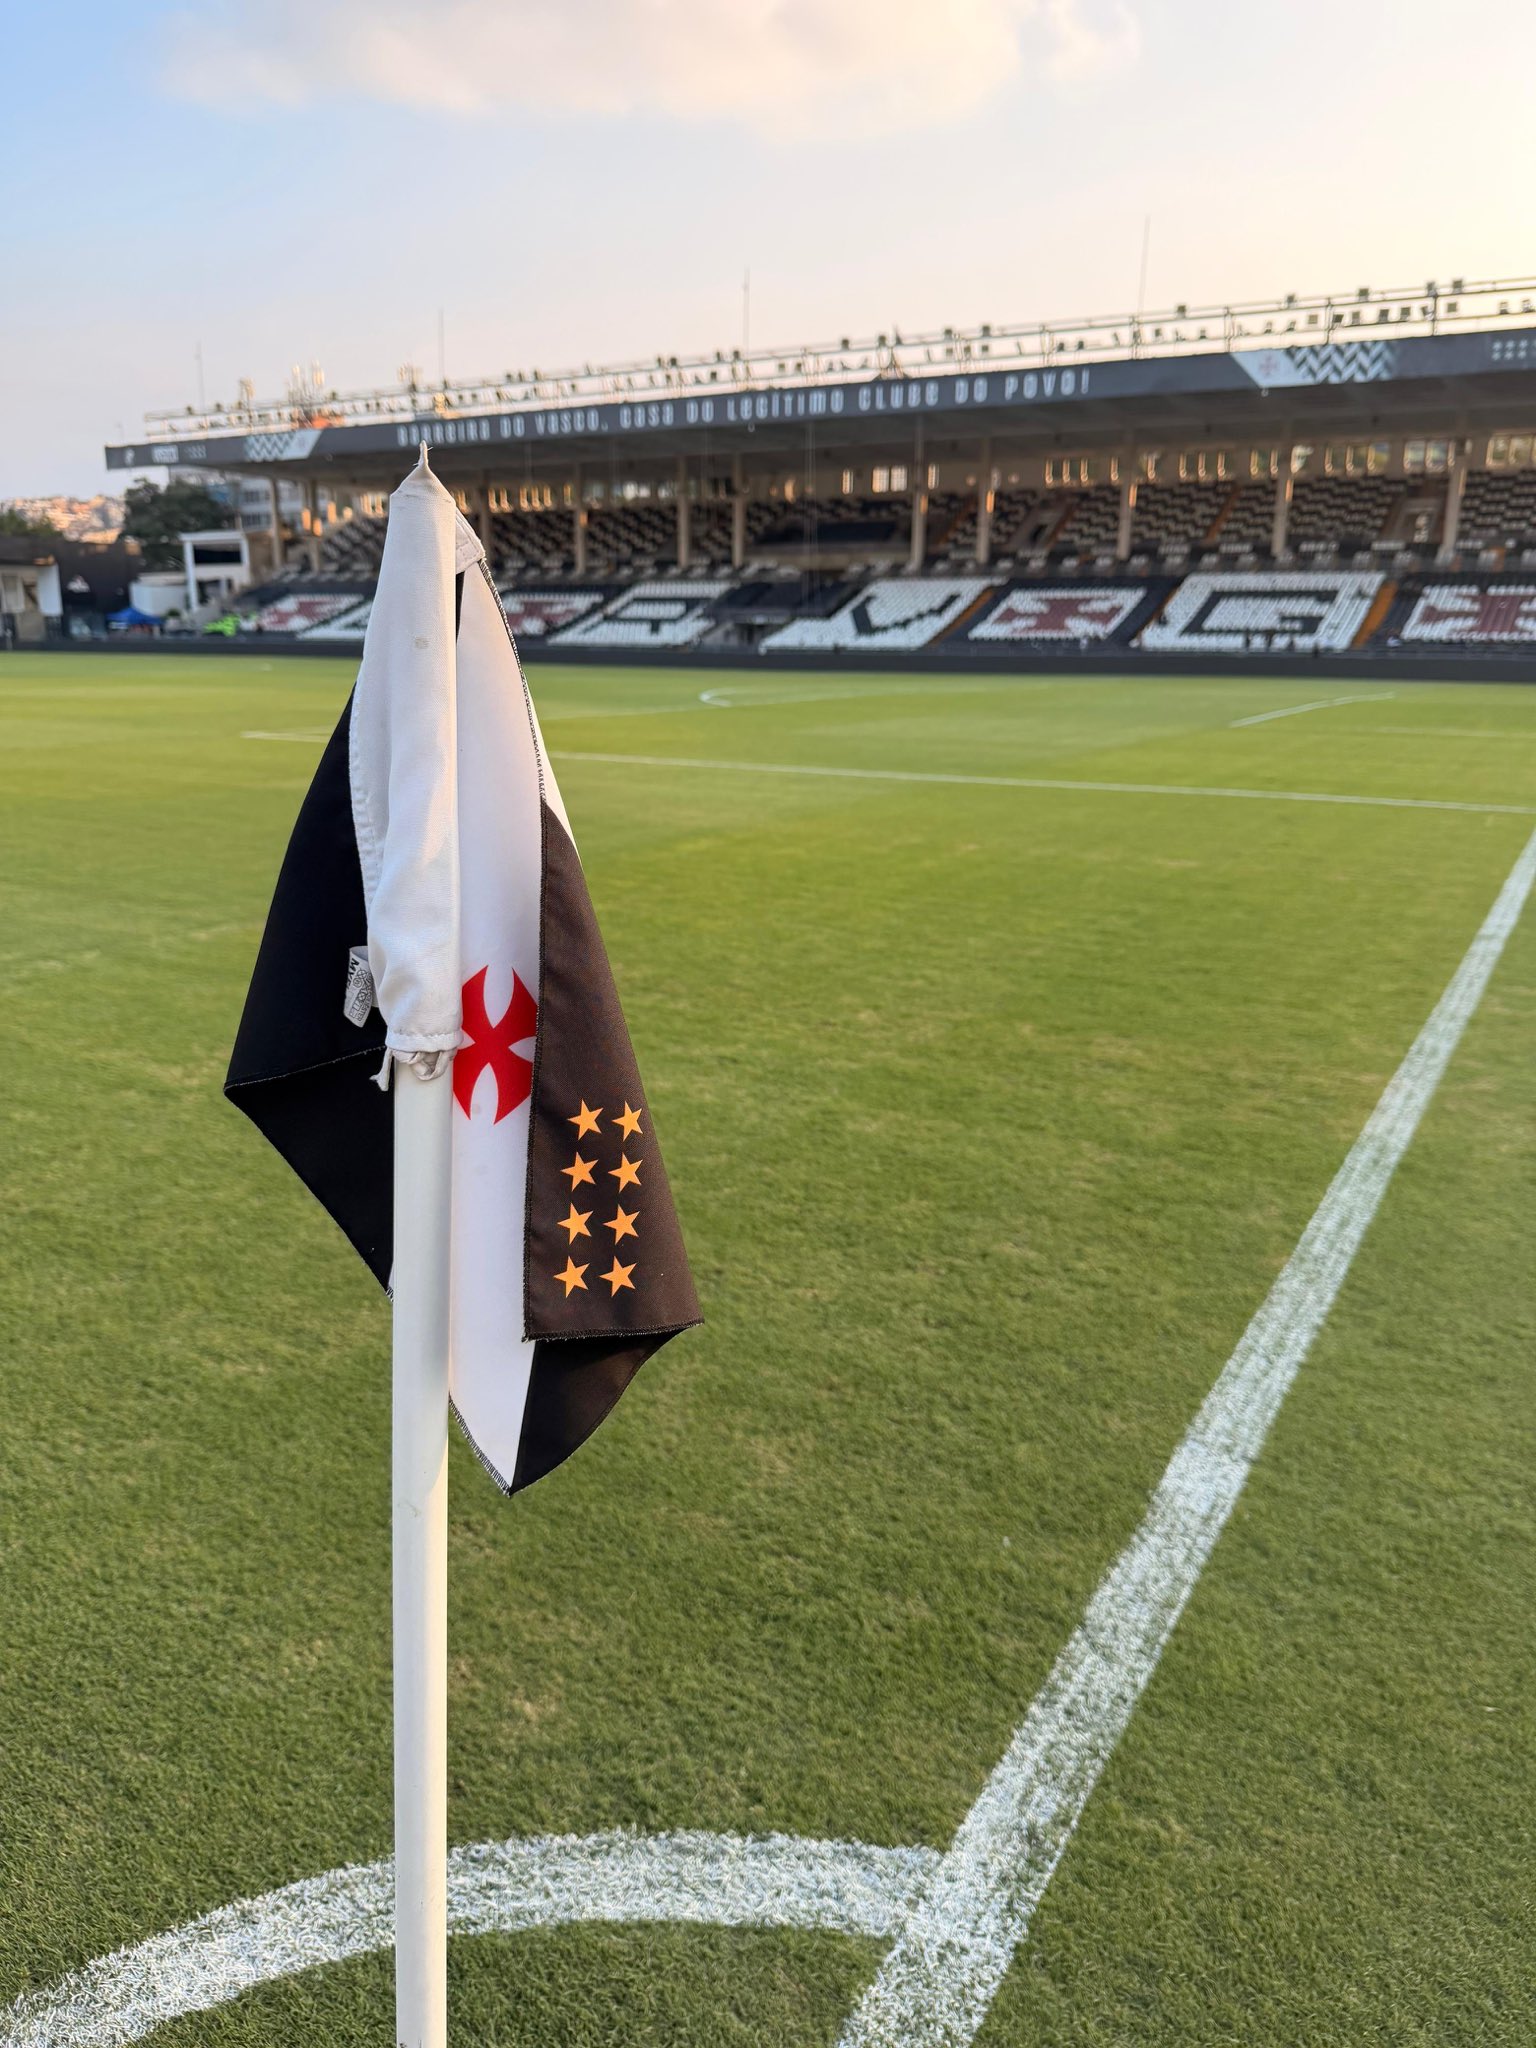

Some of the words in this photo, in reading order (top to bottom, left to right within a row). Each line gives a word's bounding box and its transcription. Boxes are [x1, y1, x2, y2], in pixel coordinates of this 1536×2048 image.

[619, 402, 674, 429] CASA
[686, 399, 715, 423] DO
[858, 381, 939, 411] CLUBE
[955, 378, 988, 404] DO
[1005, 368, 1090, 400] POVO!
